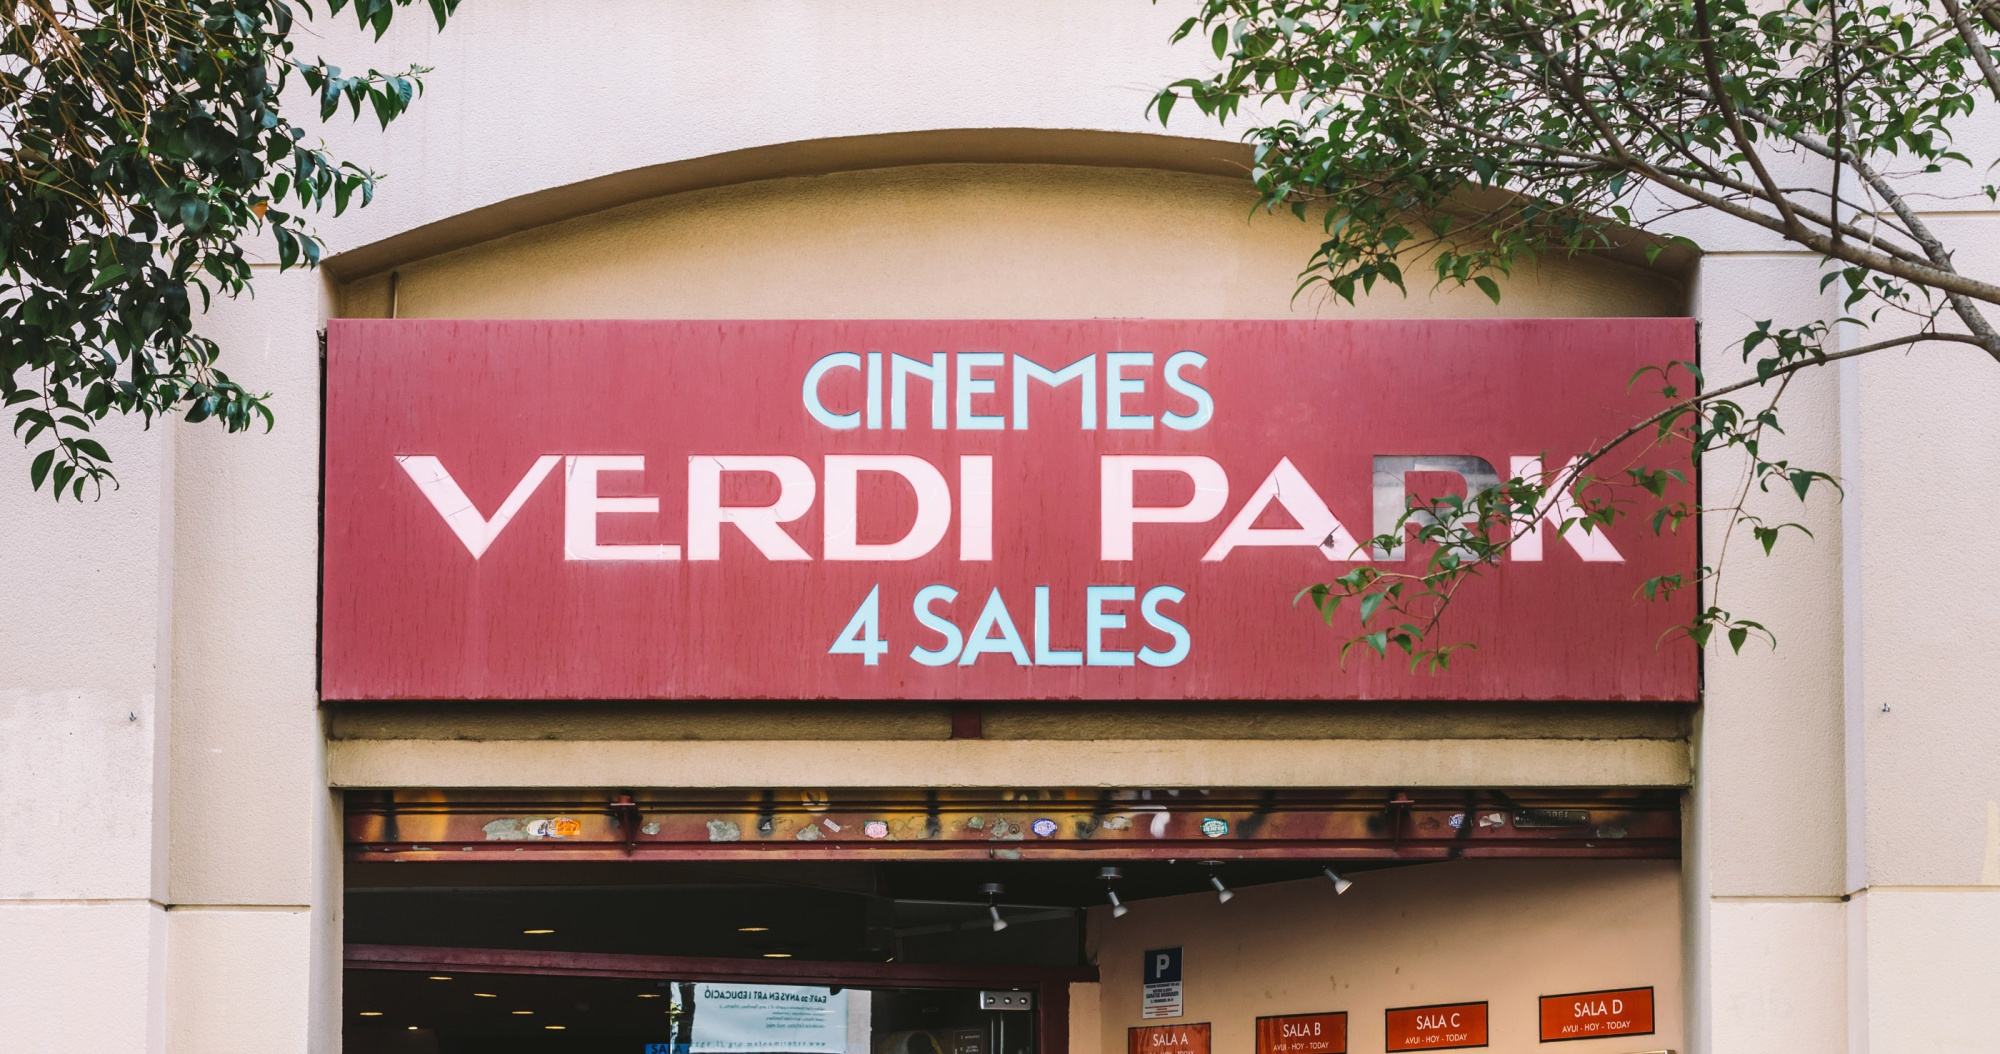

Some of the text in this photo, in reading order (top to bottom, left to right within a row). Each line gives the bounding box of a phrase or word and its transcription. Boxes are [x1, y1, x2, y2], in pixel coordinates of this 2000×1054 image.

[802, 350, 1214, 430] CINEMES
[394, 454, 1626, 562] VERDI PARK
[827, 583, 1191, 668] 4 SALES
[1156, 953, 1170, 979] P
[1574, 999, 1623, 1018] SALA D
[1283, 1022, 1321, 1038] SALA B
[1416, 1013, 1460, 1030] SALA C
[1562, 1025, 1579, 1033] AVUI
[1584, 1023, 1600, 1031] HOY
[1605, 1020, 1631, 1030] TODAY
[1153, 1032, 1188, 1047] SALA A
[1310, 1041, 1329, 1049] TODAY
[1405, 1036, 1421, 1044] AVUI
[1425, 1035, 1440, 1043] HOY
[1445, 1033, 1467, 1042] TODAY
